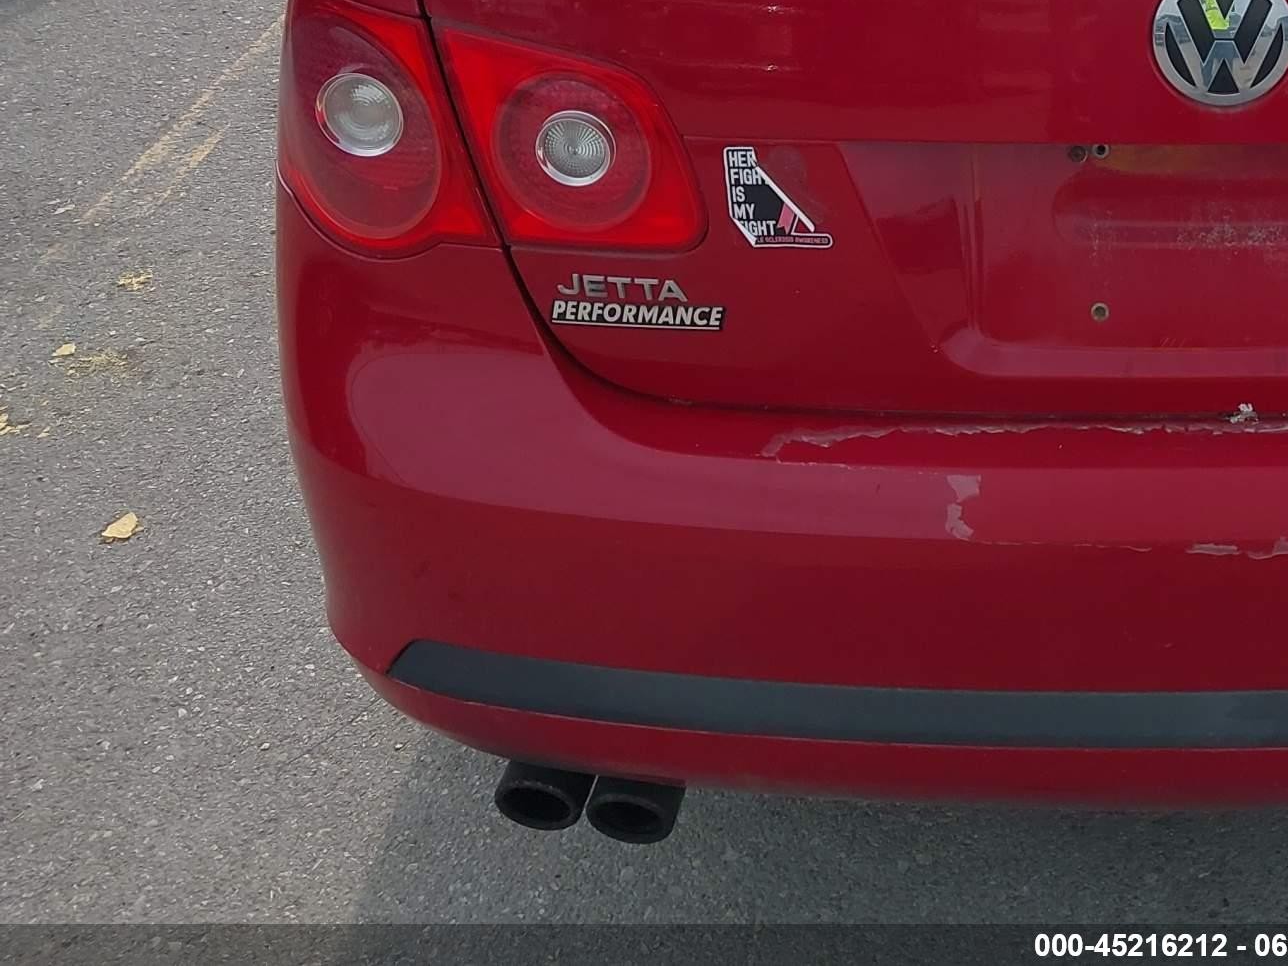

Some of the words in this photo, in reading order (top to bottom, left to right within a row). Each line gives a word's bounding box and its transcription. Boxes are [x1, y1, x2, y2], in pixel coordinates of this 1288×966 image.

[728, 151, 757, 167] HER
[730, 168, 769, 185] FIGH
[732, 186, 746, 203] IS
[734, 204, 755, 220] MY
[557, 273, 688, 302] JETTA
[552, 300, 723, 326] PERFORMANCE
